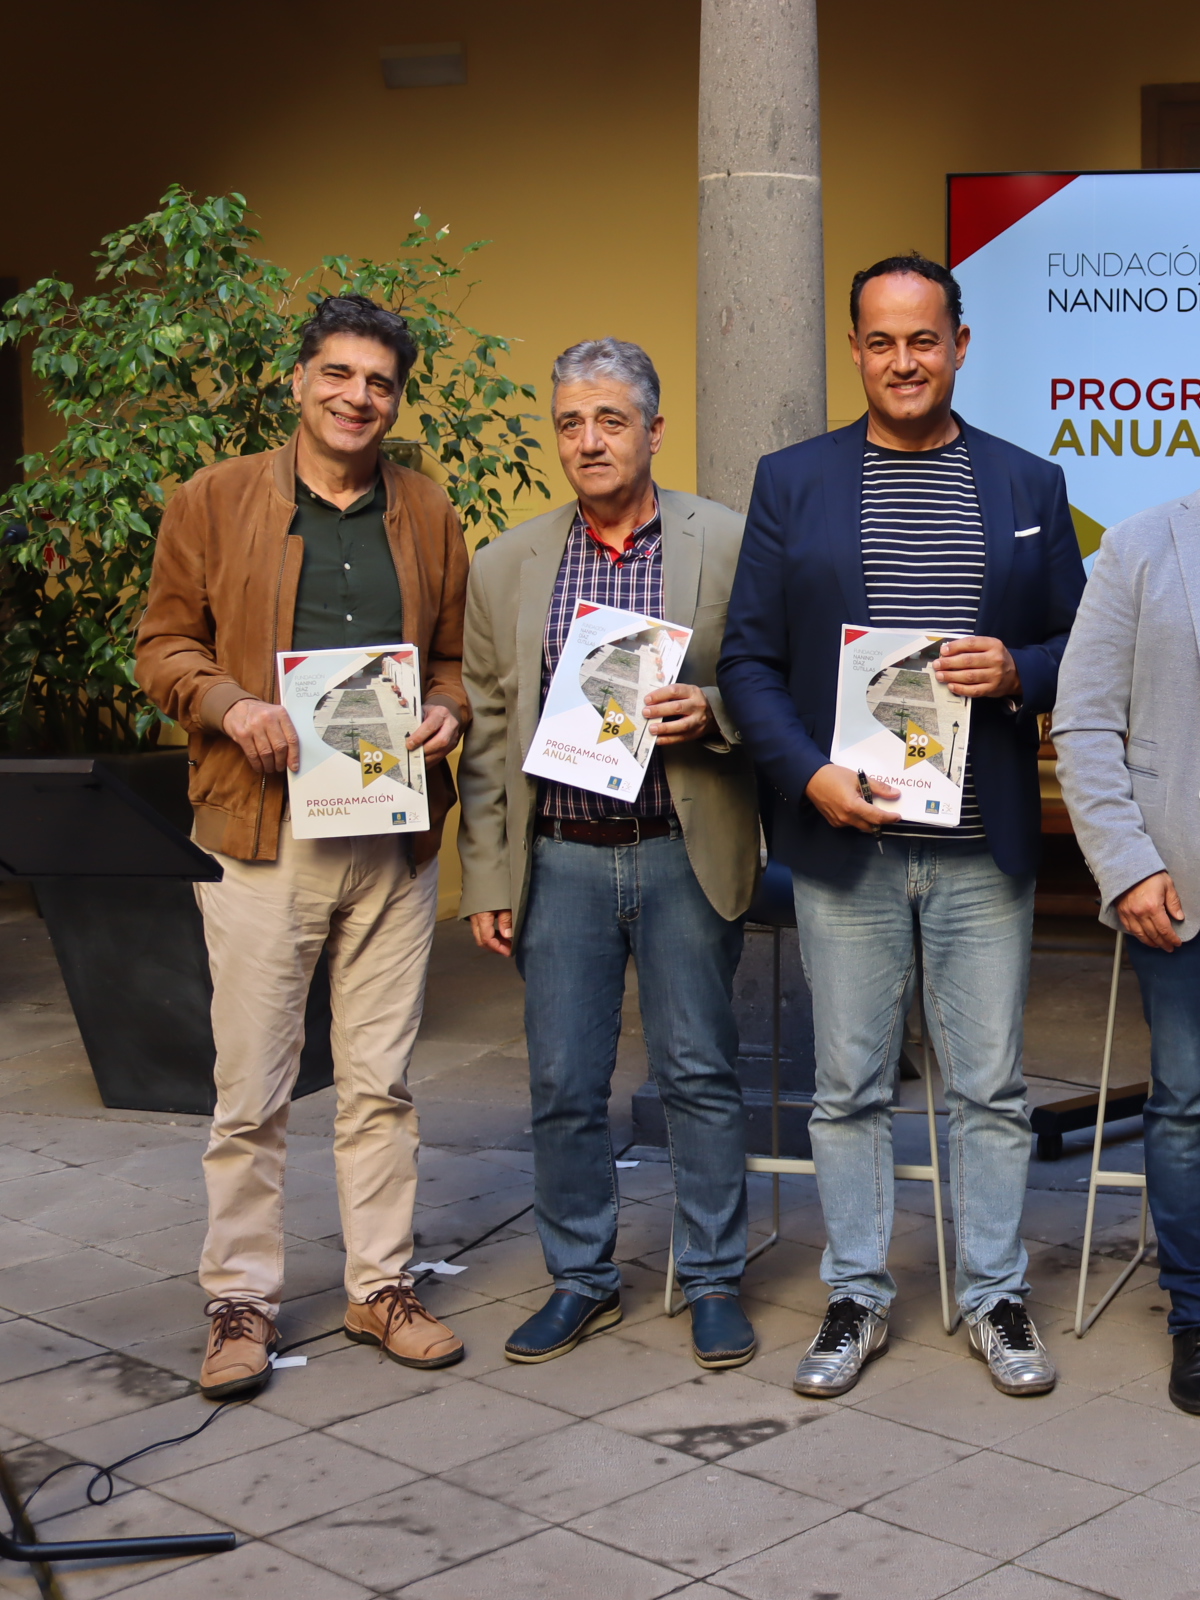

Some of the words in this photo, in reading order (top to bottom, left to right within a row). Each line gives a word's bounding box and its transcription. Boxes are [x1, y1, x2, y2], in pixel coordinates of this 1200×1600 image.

[1048, 287, 1168, 313] NANINO
[606, 710, 625, 725] 20
[603, 722, 620, 735] 26
[908, 733, 929, 747] 20
[363, 750, 384, 763] 20
[542, 748, 578, 765] ANUAL
[546, 739, 619, 765] PROGRAMACIÓN
[908, 745, 926, 758] 26
[364, 762, 383, 774] 26
[306, 793, 394, 807] PROGRAMACIÓN
[307, 806, 351, 817] ANUAL
